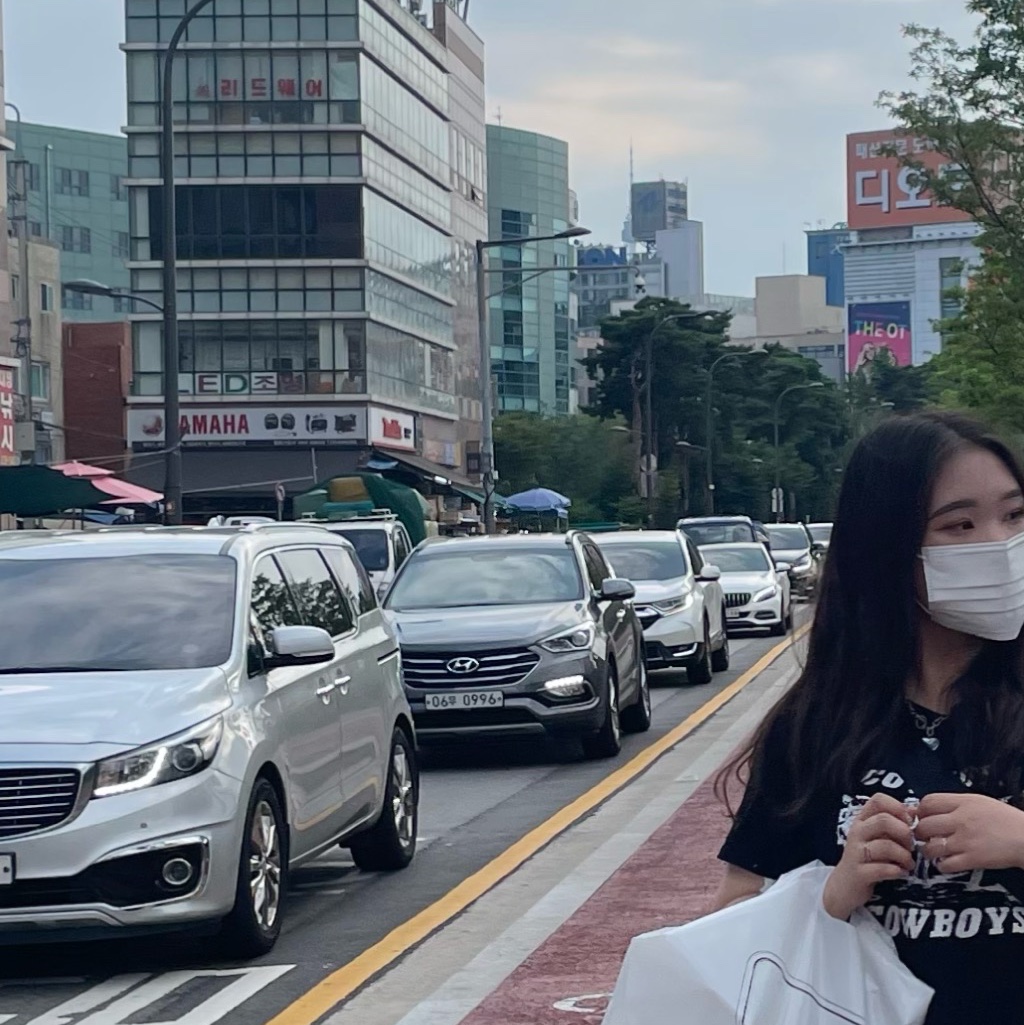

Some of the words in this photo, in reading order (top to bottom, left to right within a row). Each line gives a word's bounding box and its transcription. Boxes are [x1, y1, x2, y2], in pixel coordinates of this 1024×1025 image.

[853, 320, 884, 338] THE
[178, 413, 250, 436] AMAHA
[463, 693, 497, 706] 0996
